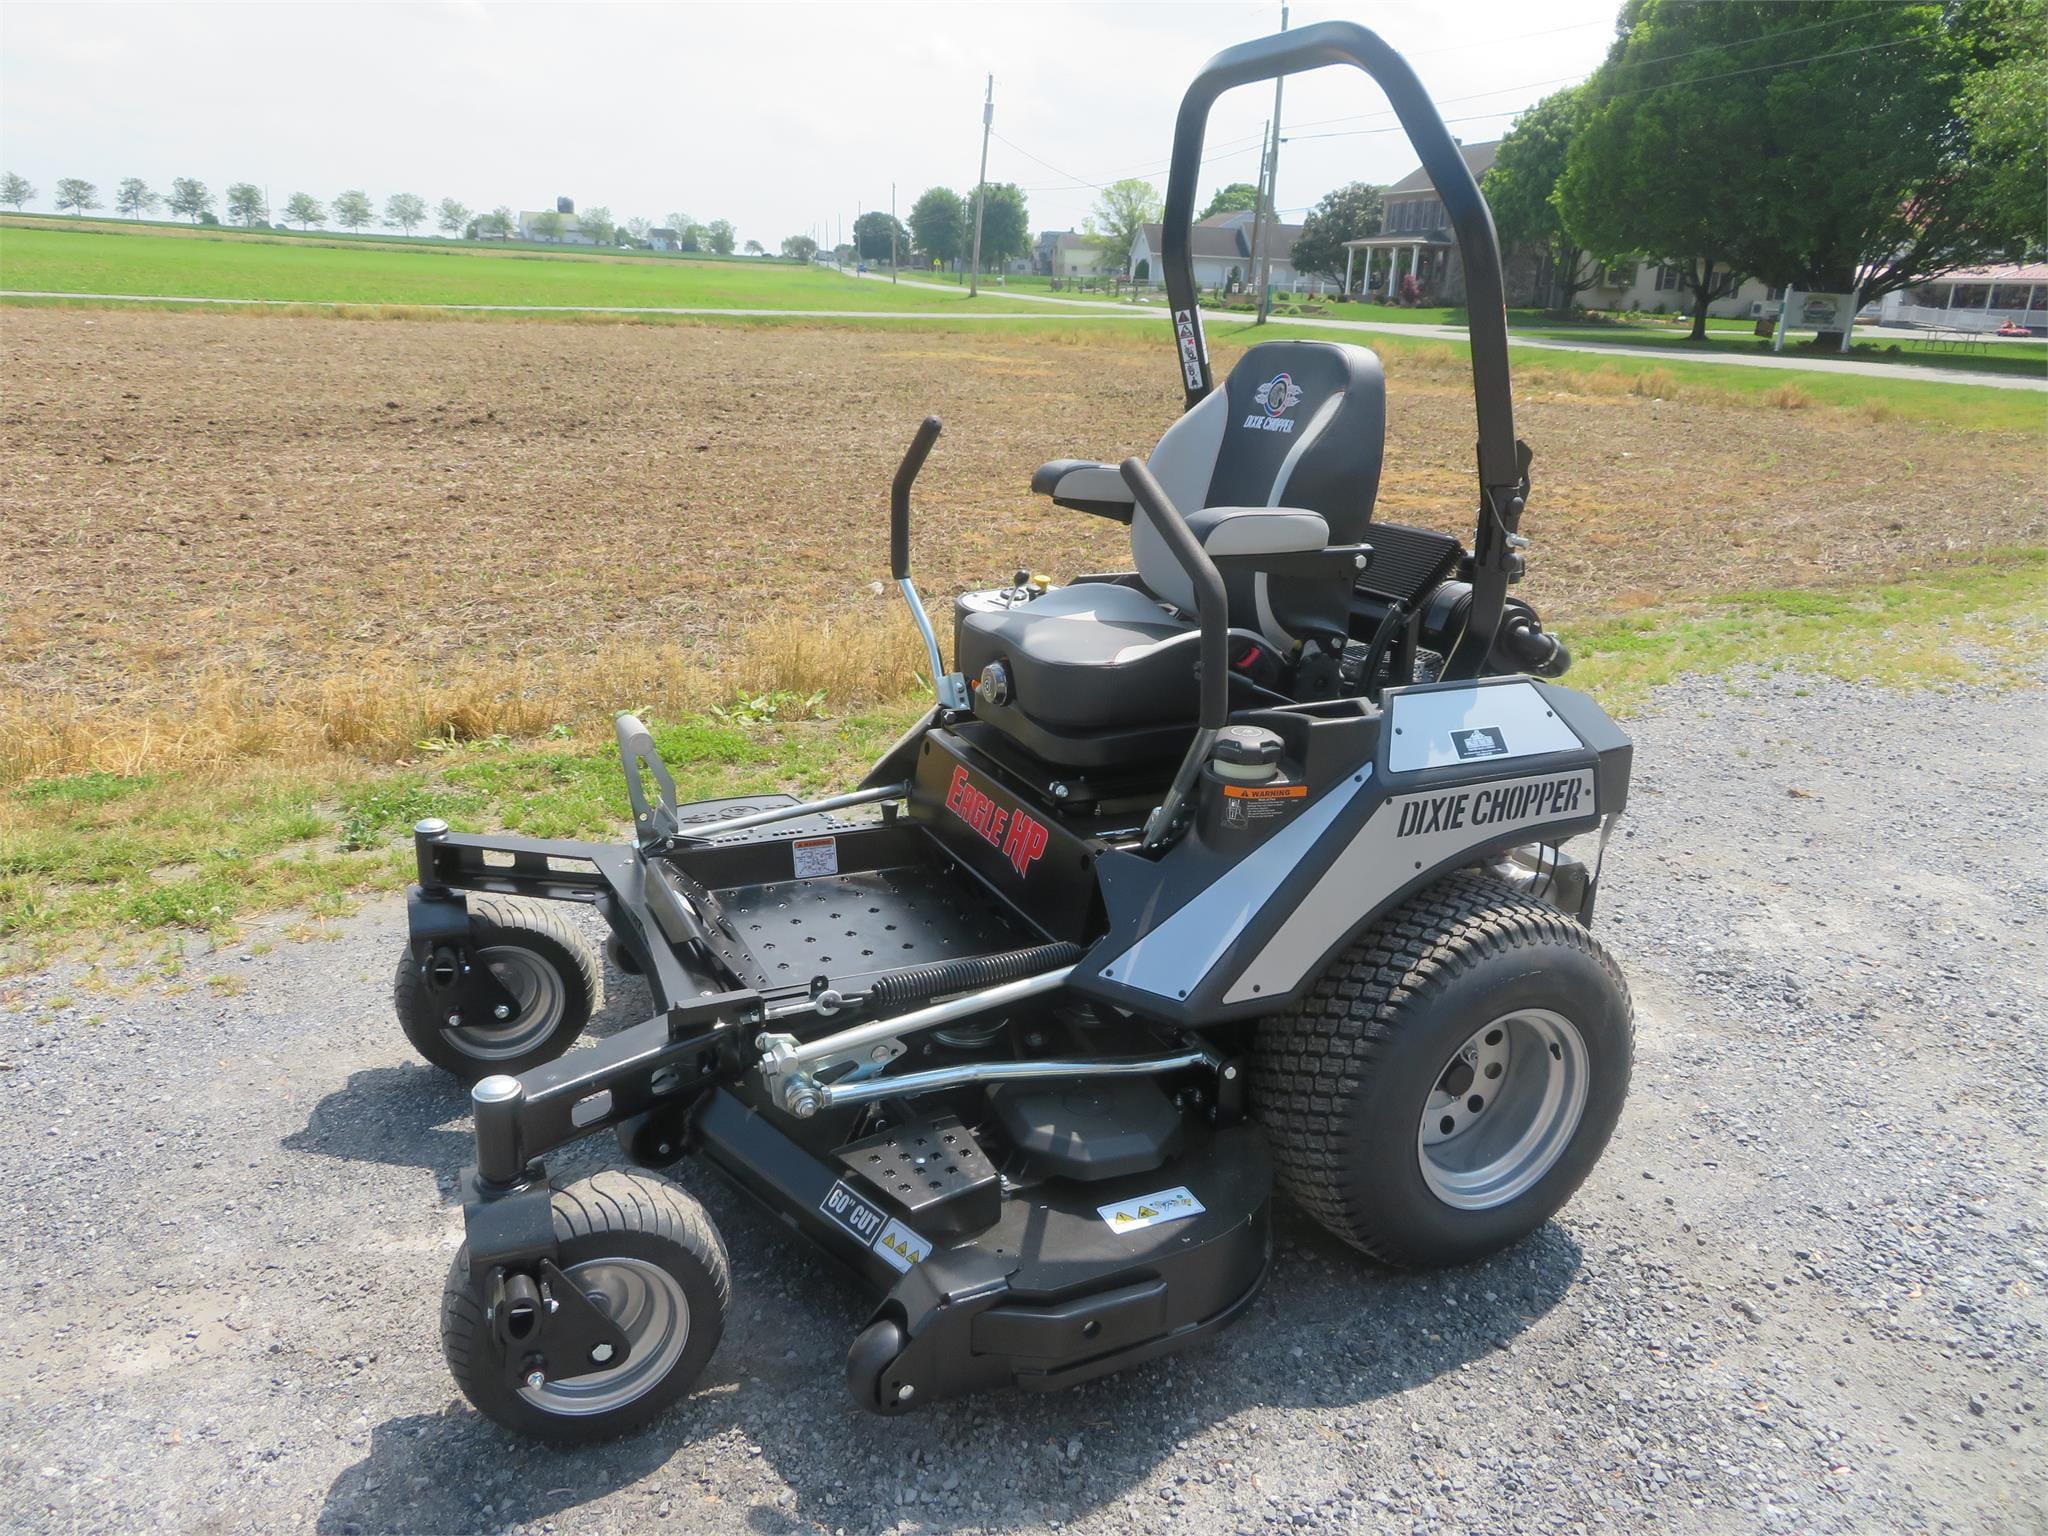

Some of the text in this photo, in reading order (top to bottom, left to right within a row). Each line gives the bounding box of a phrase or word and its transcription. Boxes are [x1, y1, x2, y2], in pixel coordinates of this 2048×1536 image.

[1243, 415, 1295, 433] DIXIE CHOPPER
[1251, 789, 1291, 798] WARNING
[1397, 778, 1583, 837] DIXIE CHOPPER
[945, 764, 1049, 879] EAGLE HP
[849, 1205, 880, 1235] CUT
